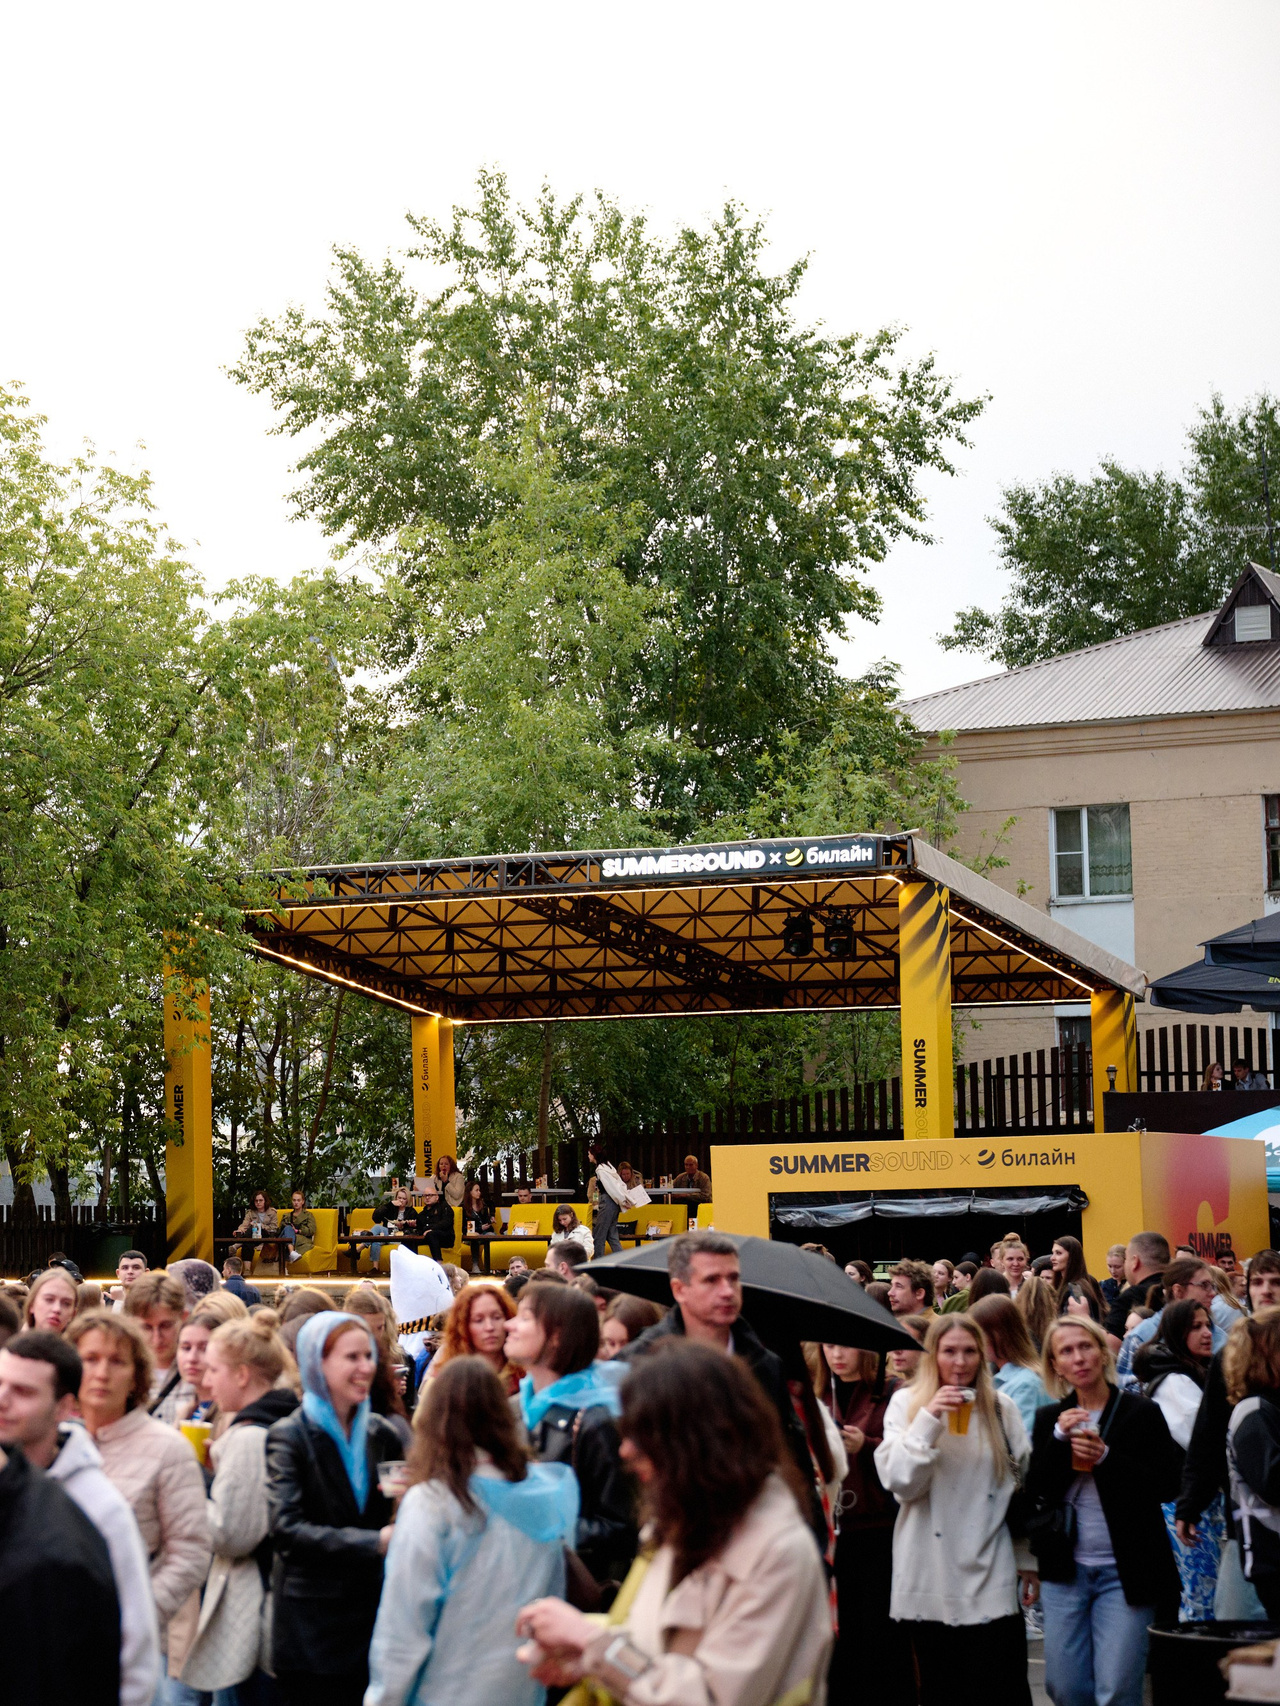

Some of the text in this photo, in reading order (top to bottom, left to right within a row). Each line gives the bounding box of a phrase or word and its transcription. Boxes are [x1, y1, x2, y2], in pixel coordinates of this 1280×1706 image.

[602, 850, 766, 877] SUMMERSOUND
[806, 845, 873, 864] билайн
[421, 1047, 430, 1081] билайн
[770, 1149, 953, 1175] SUMMERSOUND
[1001, 1148, 1075, 1166] билайн
